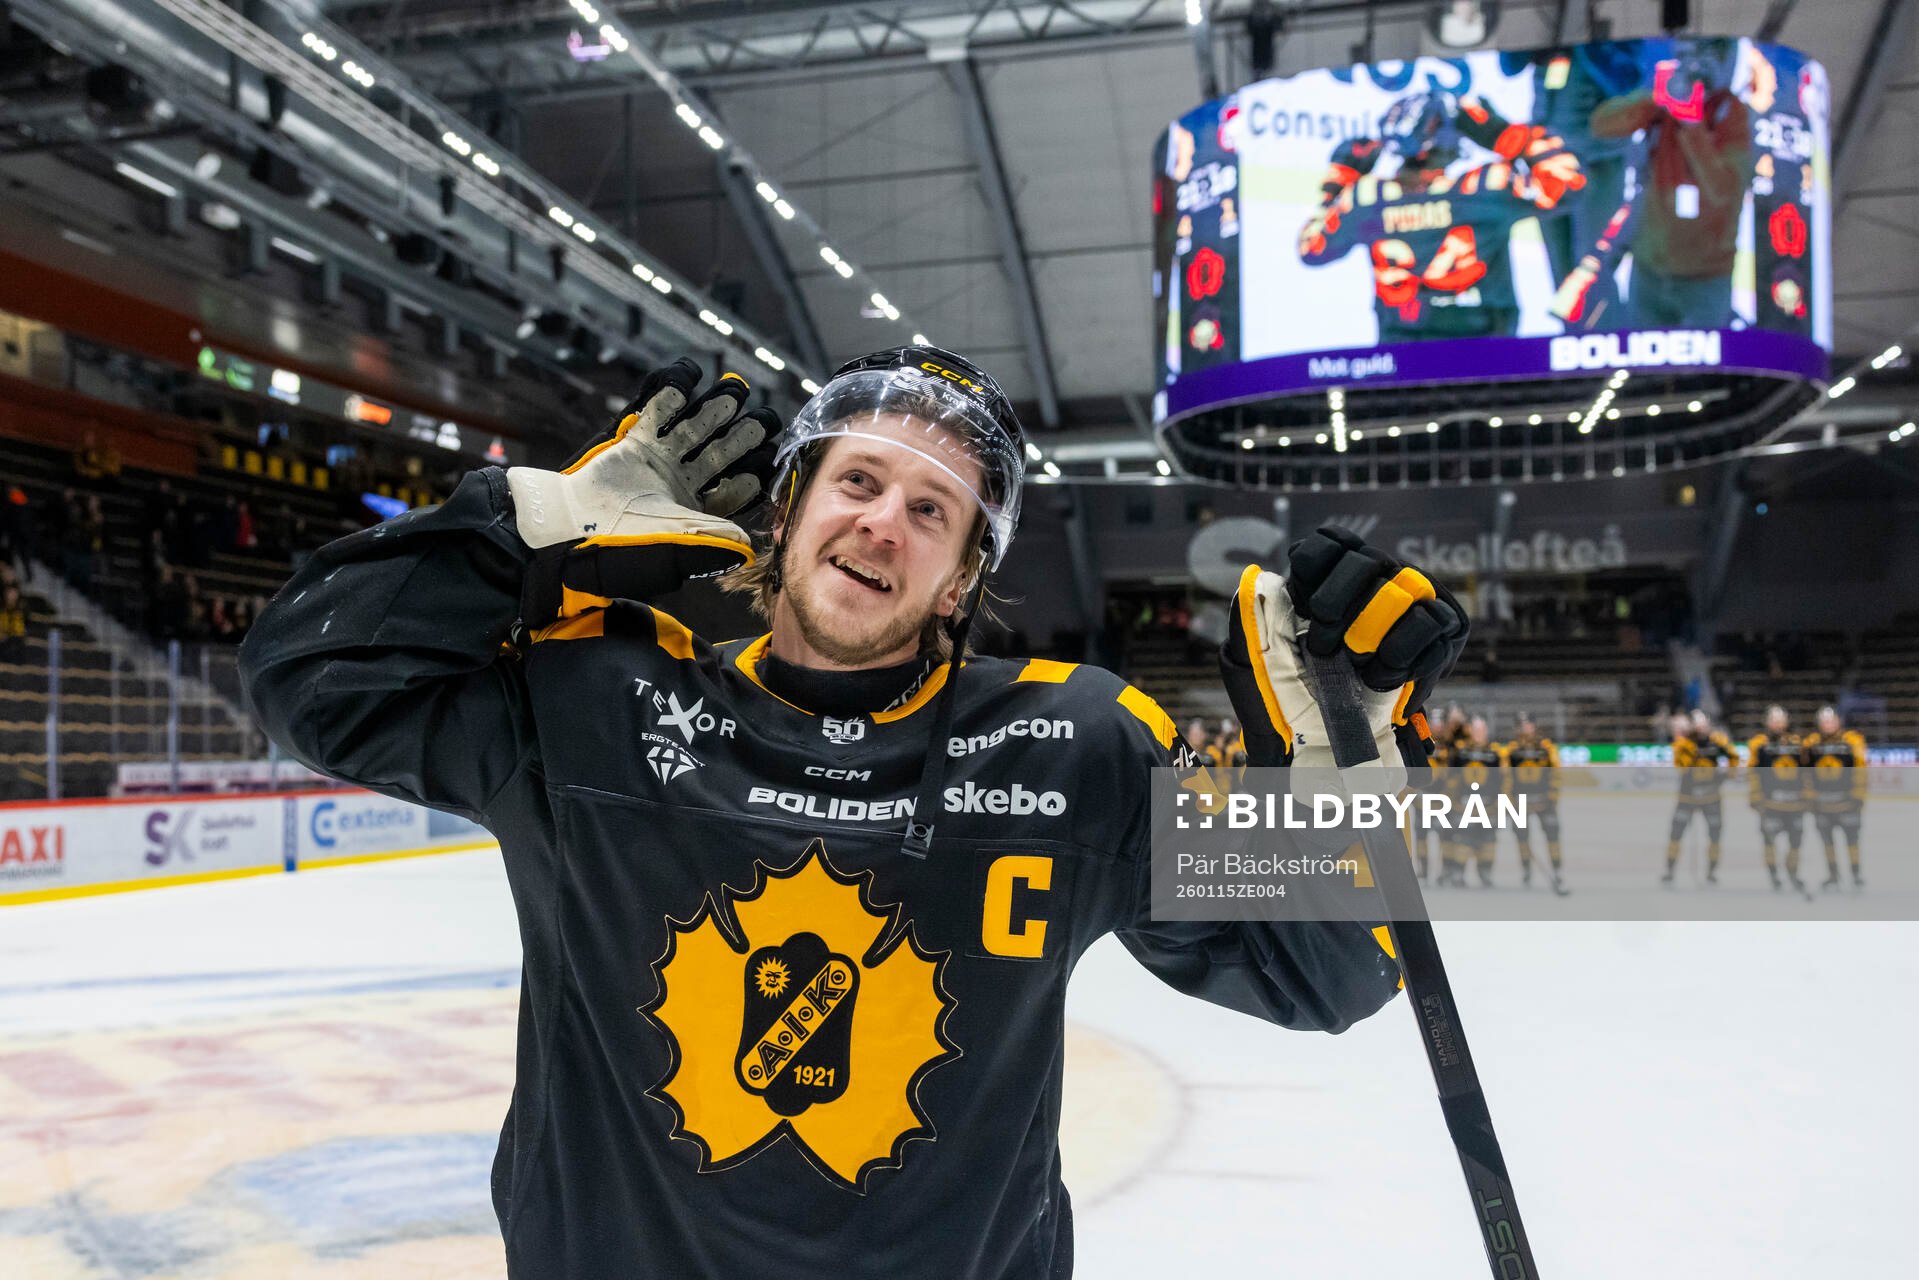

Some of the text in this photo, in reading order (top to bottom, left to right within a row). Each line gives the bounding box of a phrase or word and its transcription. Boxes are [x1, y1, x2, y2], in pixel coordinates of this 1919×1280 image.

[1550, 329, 1721, 371] BOLIDEN
[920, 361, 984, 394] CCM
[634, 678, 737, 746] TEXOR
[946, 717, 1075, 758] engcon
[804, 765, 873, 782] CCM
[747, 786, 920, 822] BOLIDEN
[943, 781, 1067, 816] skebo
[981, 855, 1053, 958] C
[793, 1064, 836, 1087] 1921
